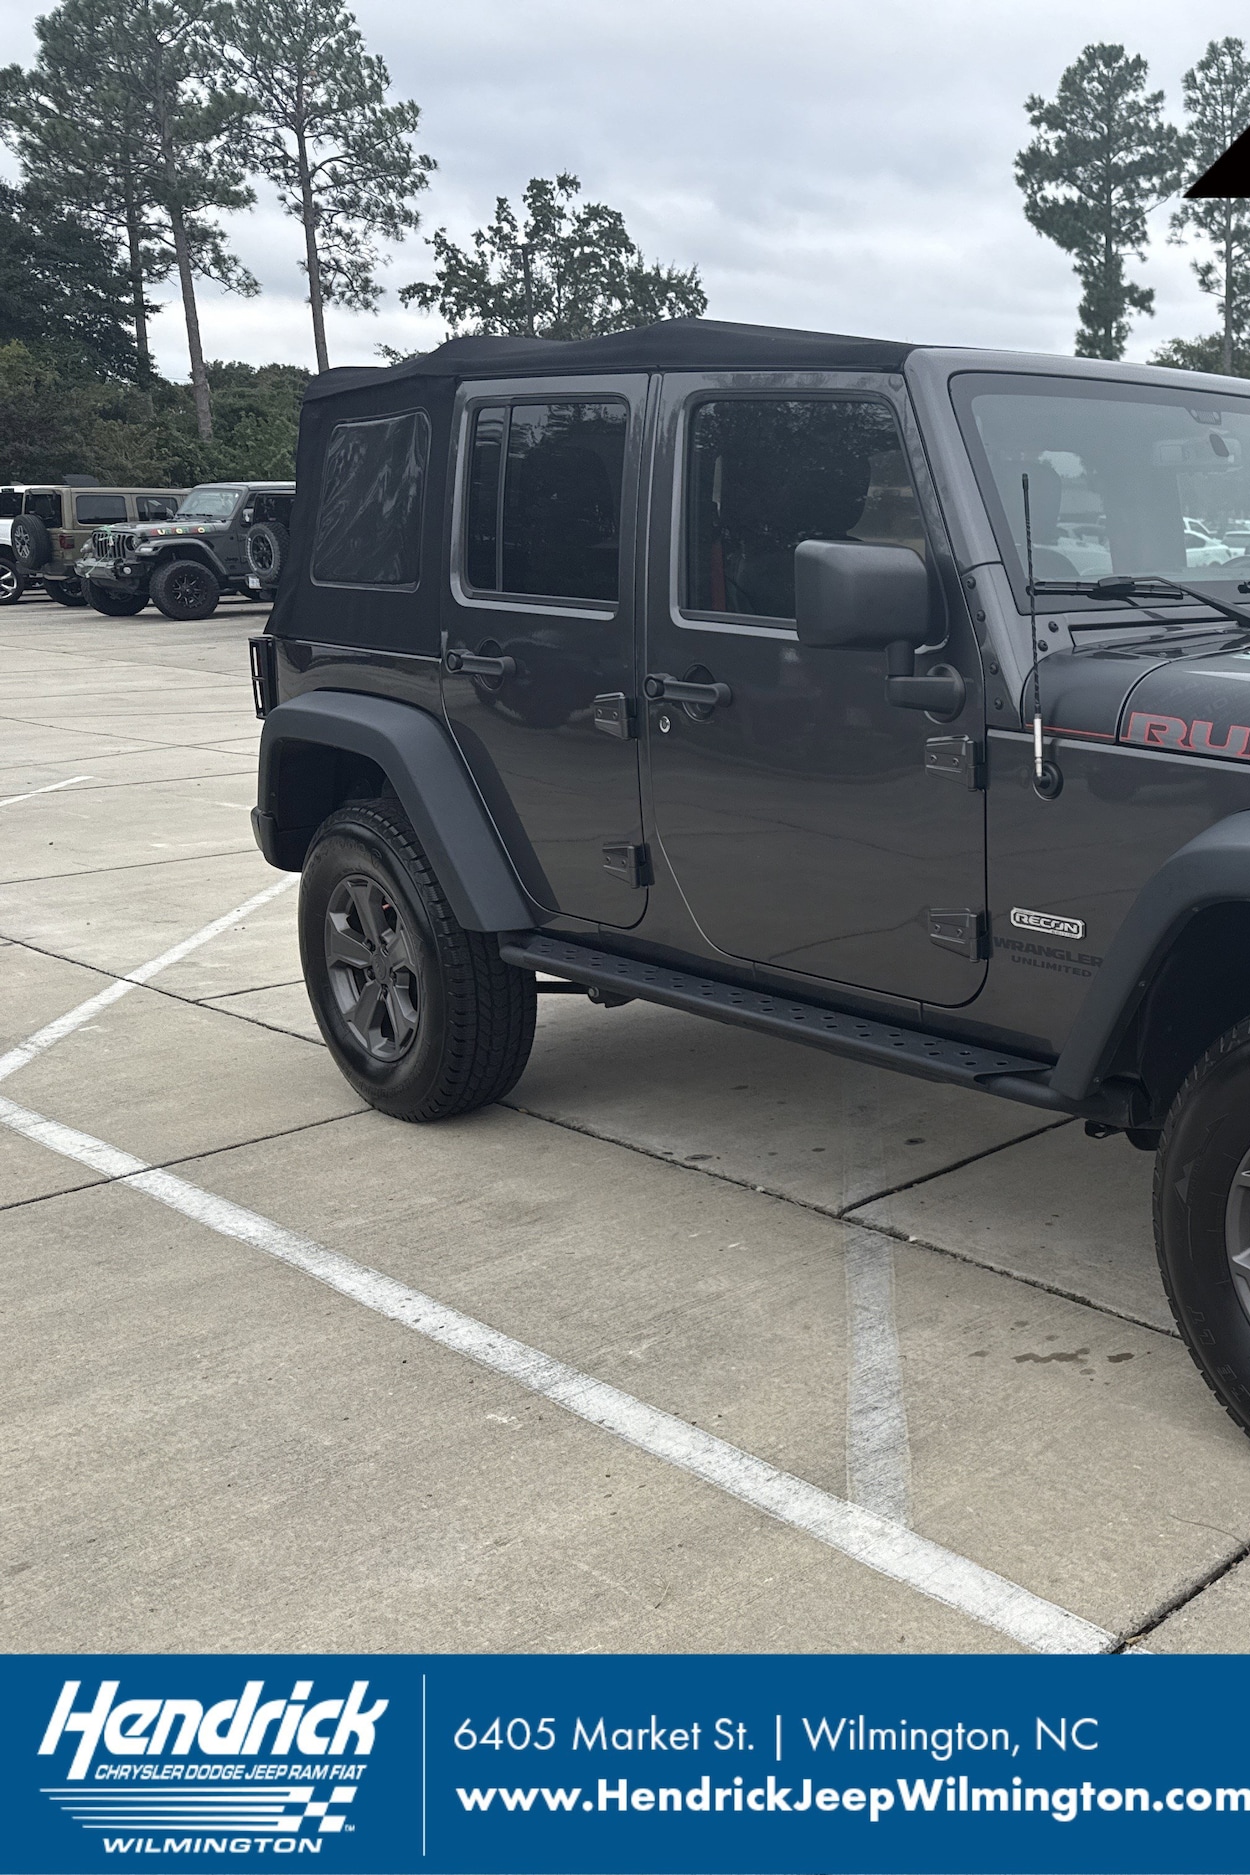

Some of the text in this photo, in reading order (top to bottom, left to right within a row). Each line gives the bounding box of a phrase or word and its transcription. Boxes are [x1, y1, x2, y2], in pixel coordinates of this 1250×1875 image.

[1014, 912, 1078, 934] RECON
[993, 936, 1104, 968] WRANGLER
[1011, 955, 1093, 977] UNLIMITED
